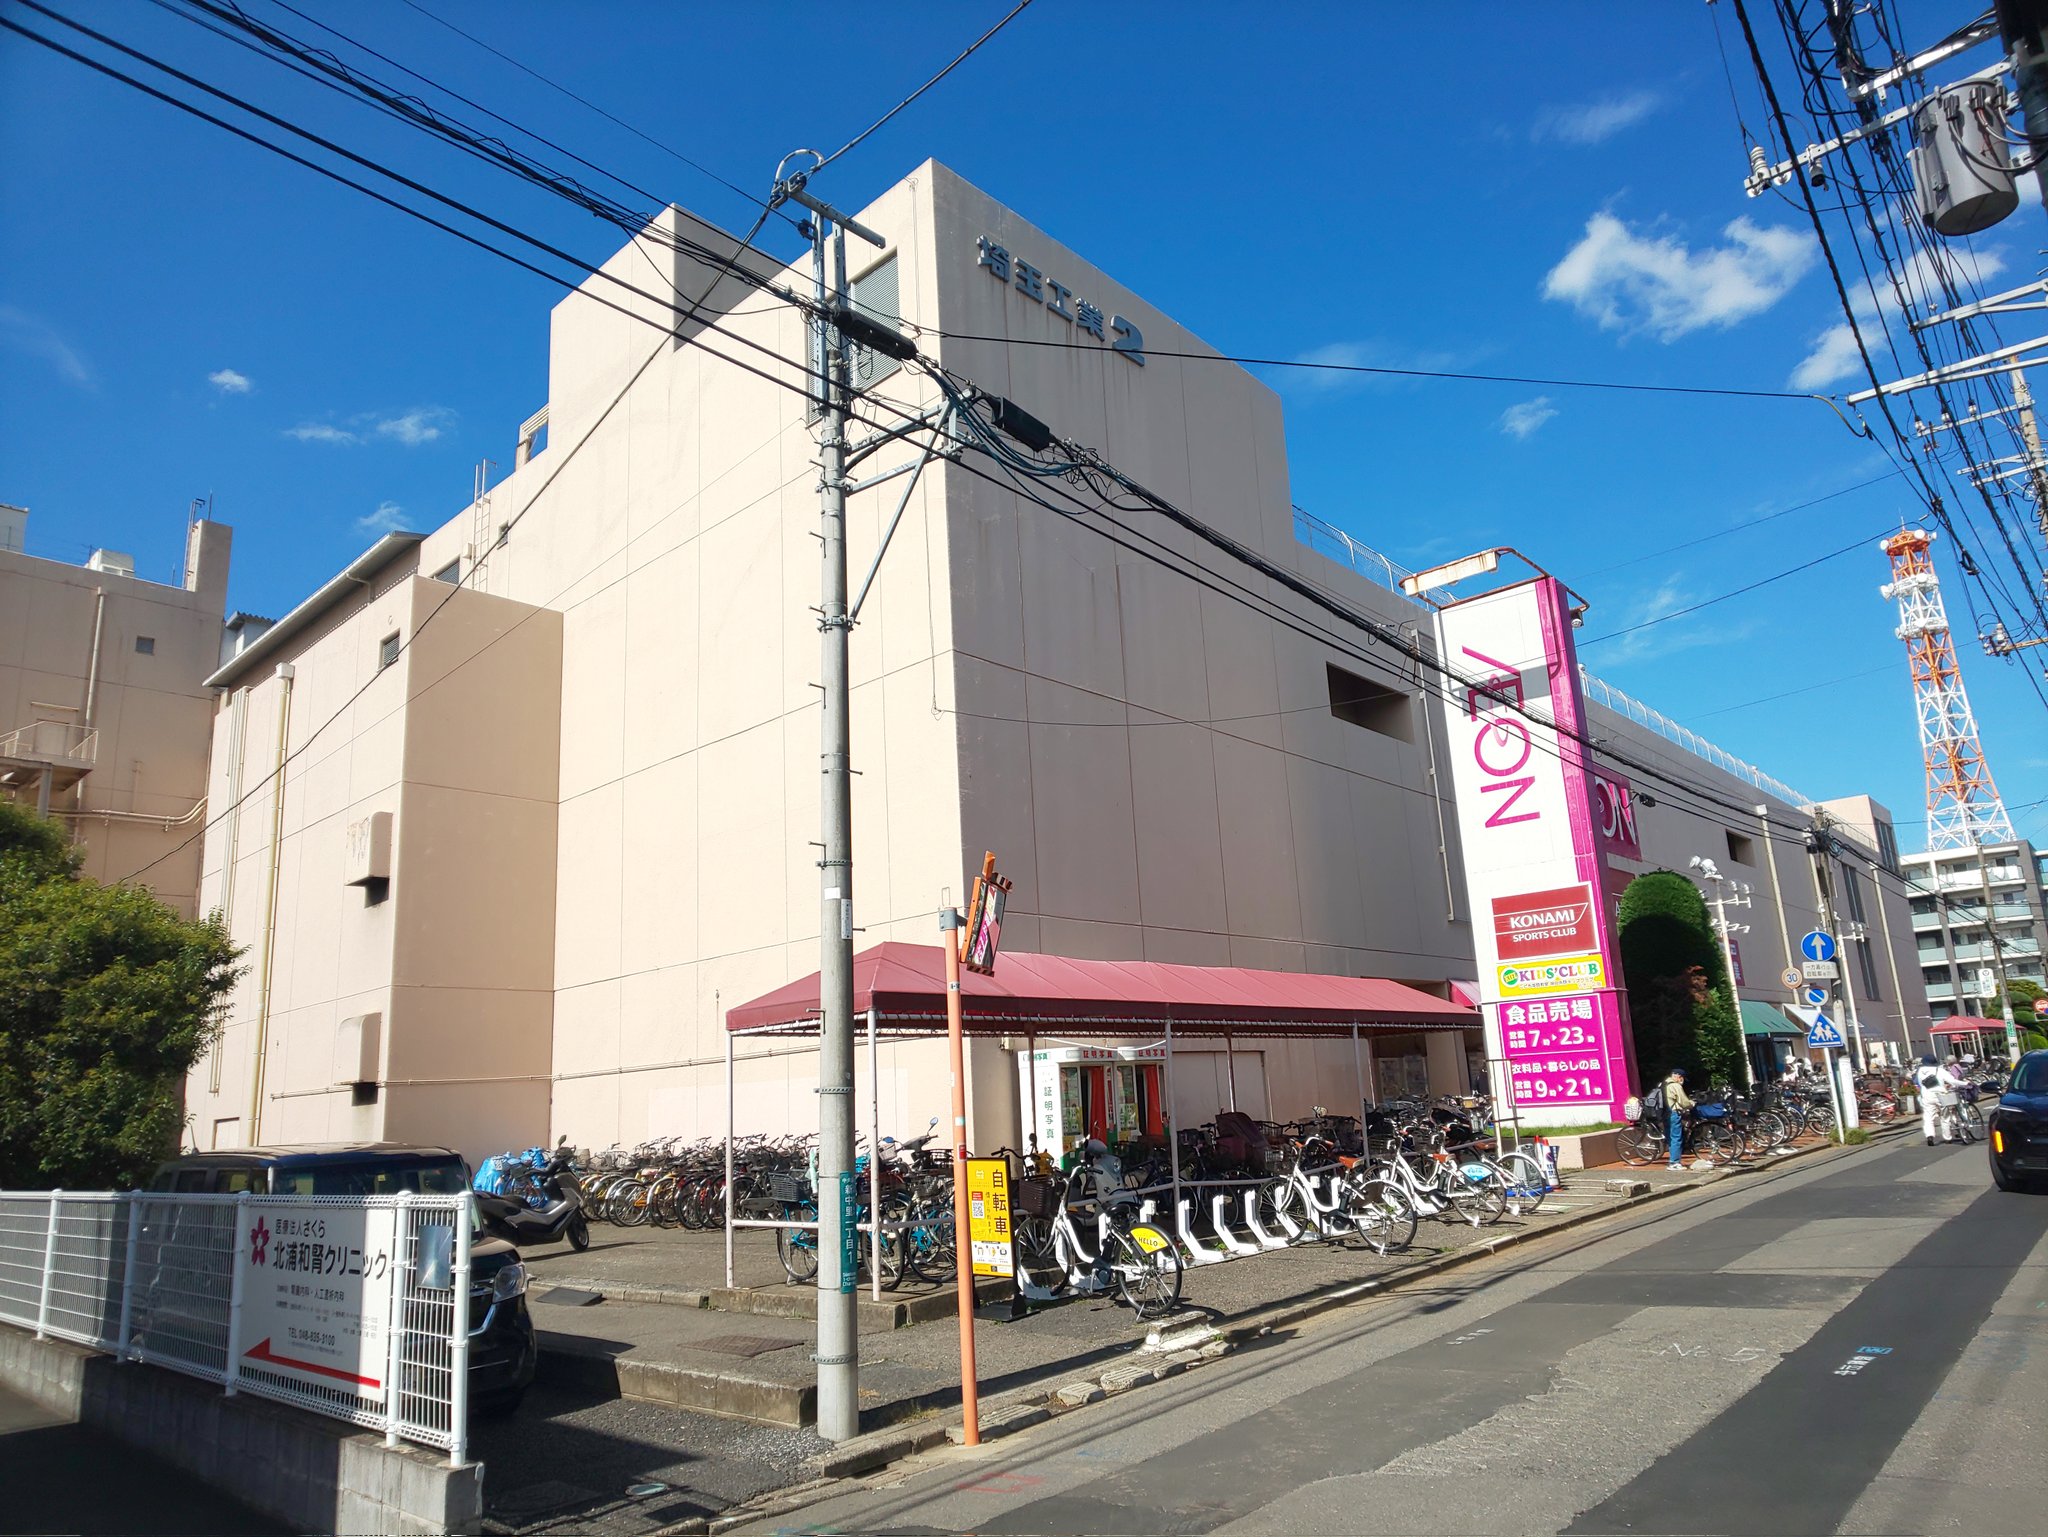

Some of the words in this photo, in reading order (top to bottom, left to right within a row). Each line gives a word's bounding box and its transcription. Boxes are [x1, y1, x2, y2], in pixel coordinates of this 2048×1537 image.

[1509, 909, 1575, 929] KONAMI
[1512, 931, 1549, 943] SPORTS
[1550, 927, 1577, 938] CLUB
[1786, 973, 1798, 983] 30
[1506, 1000, 1593, 1026] 食品売場
[1511, 1059, 1600, 1074] 衣料品・暮らしの品
[992, 1169, 1008, 1235] 自転車
[275, 1219, 325, 1238] 医療法人さくら
[1138, 1236, 1159, 1247] HELLO
[273, 1241, 386, 1279] 北浦和腎クリニック
[288, 1327, 298, 1339] TEL
